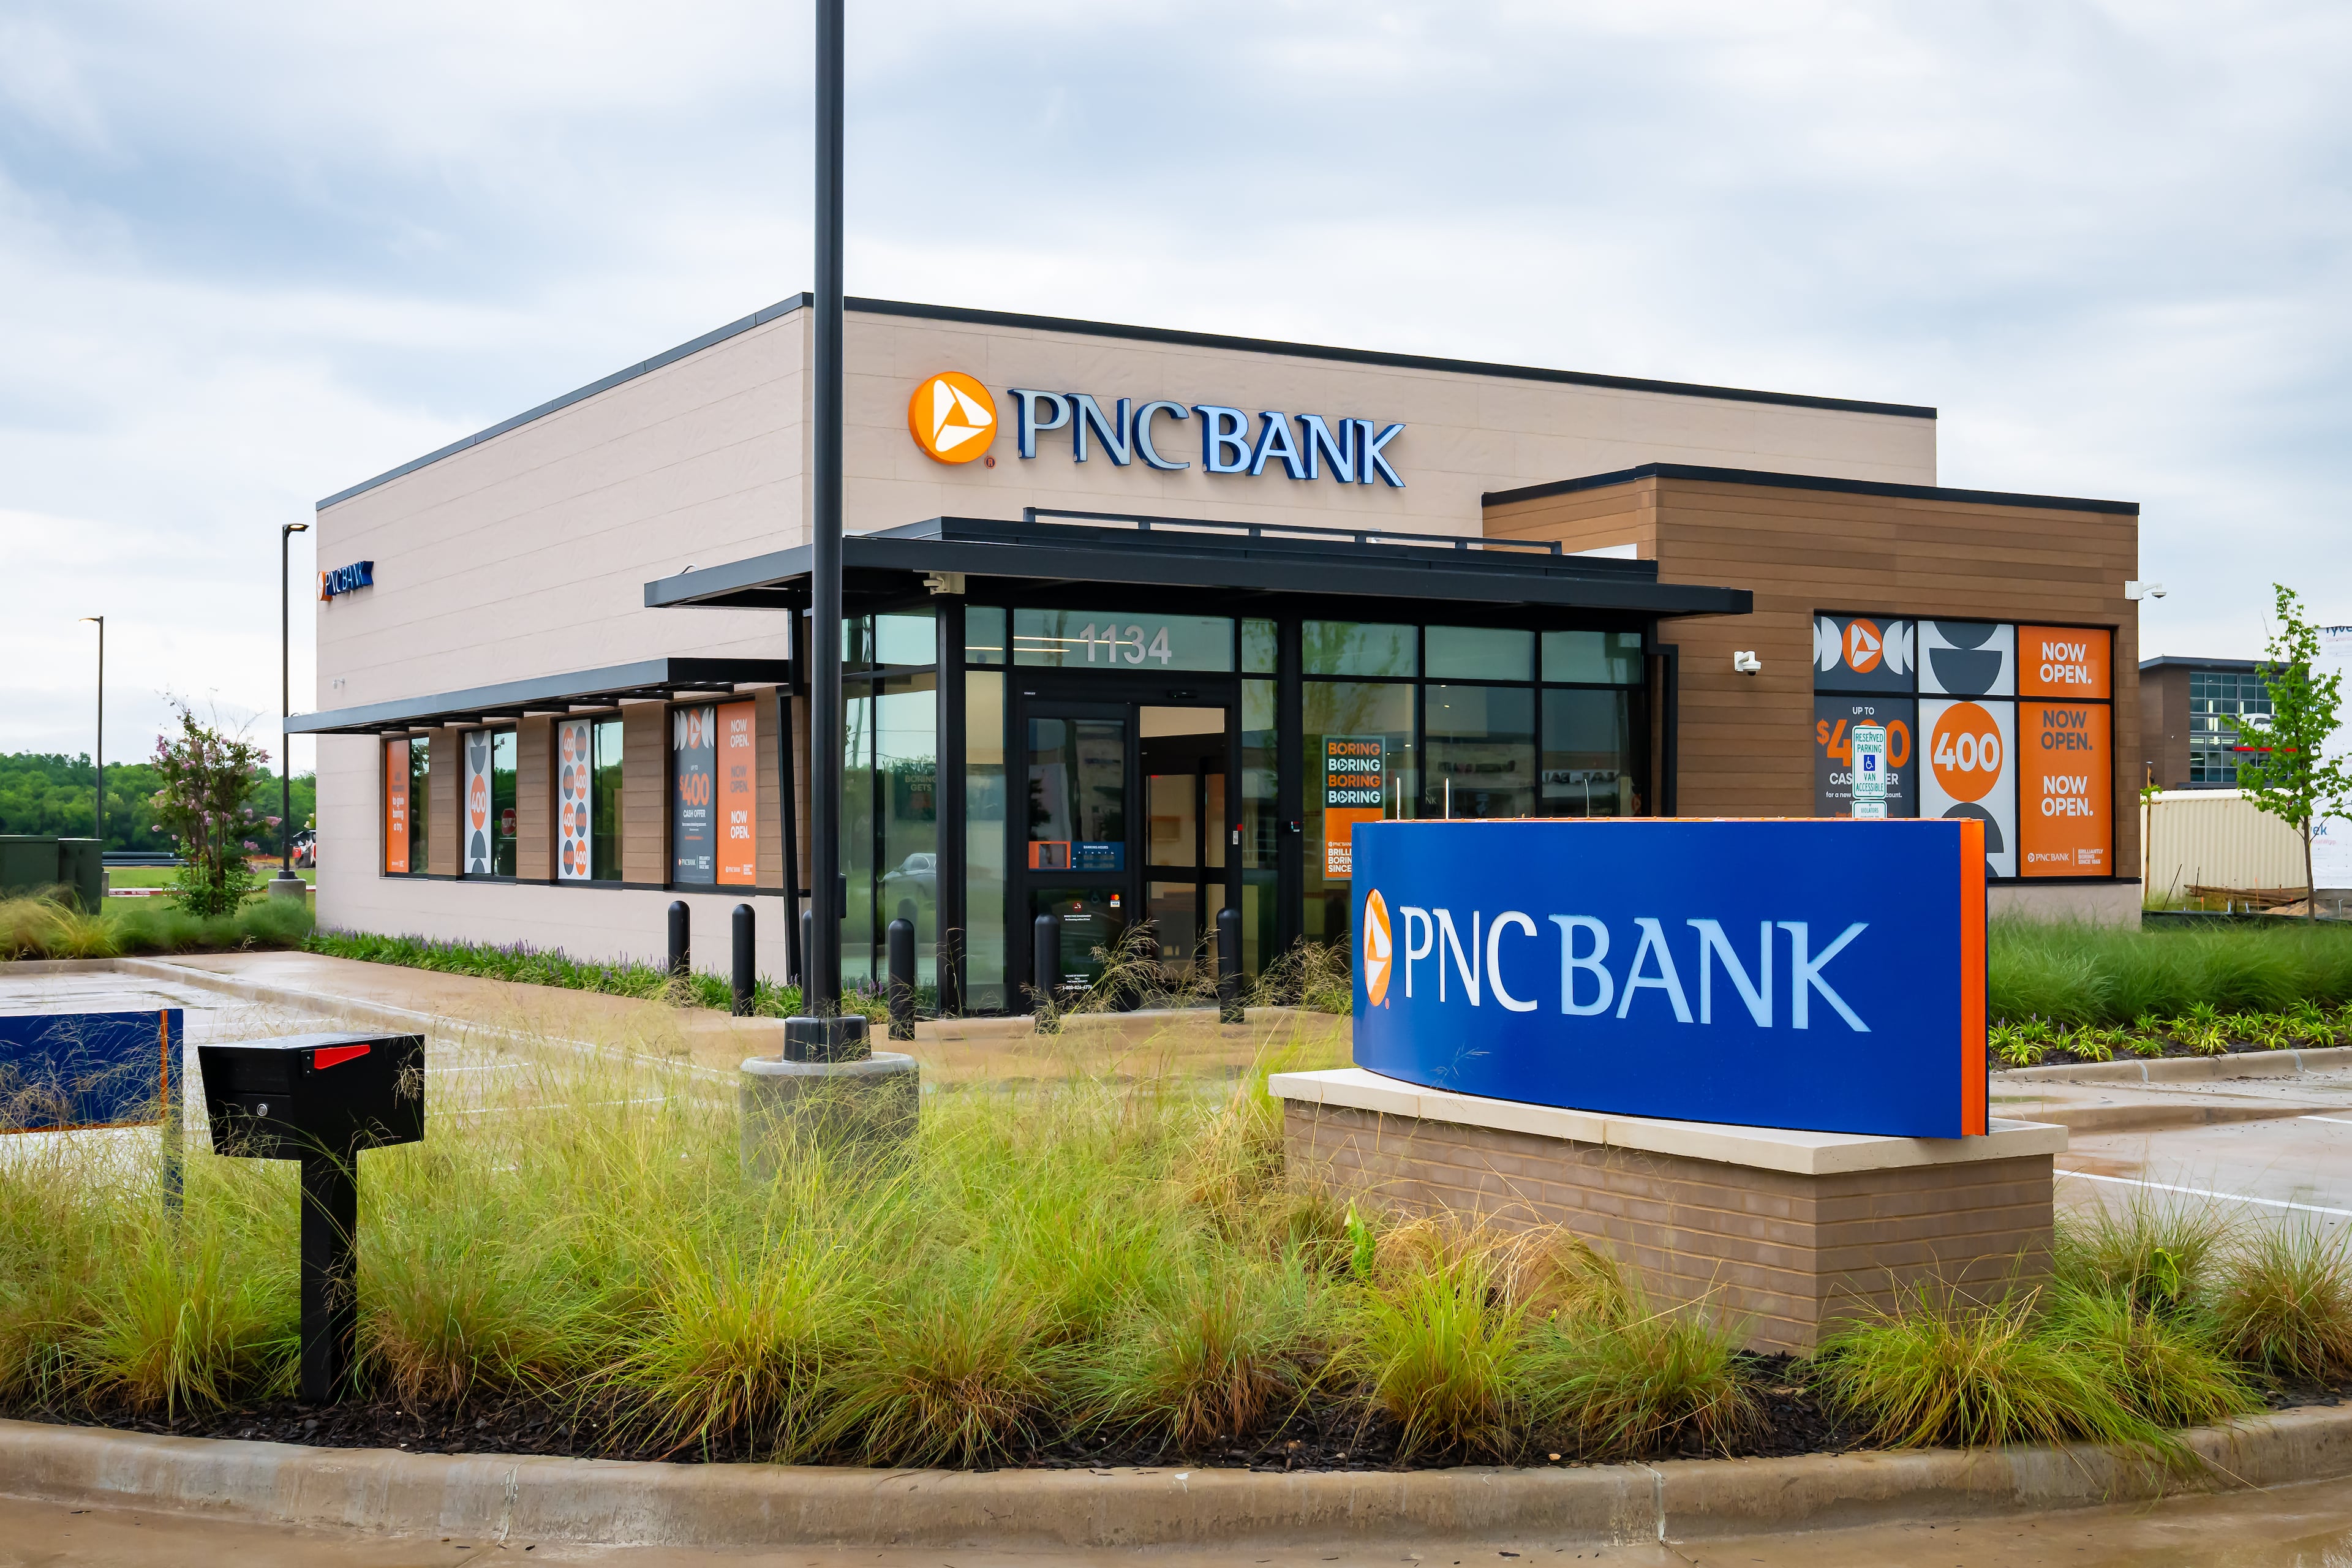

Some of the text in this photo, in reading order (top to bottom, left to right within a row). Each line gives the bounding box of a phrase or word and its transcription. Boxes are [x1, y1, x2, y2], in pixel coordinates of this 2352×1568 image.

[1008, 388, 1406, 488] PNC BANK
[1080, 623, 1172, 665] 1134
[2042, 642, 2086, 662] NOW
[2040, 663, 2092, 684] OPEN.
[1852, 706, 1875, 715] UP TO
[731, 718, 747, 733] NOW
[2043, 710, 2087, 728] NOW
[564, 737, 575, 752] 400
[730, 734, 750, 748] OPEN.
[1817, 718, 1910, 768] $40
[1855, 733, 1883, 743] RESERVED
[2041, 731, 2093, 751] OPEN.
[1329, 742, 1381, 755] BORING
[1857, 744, 1882, 753] PARKING
[1934, 732, 2000, 772] 400
[731, 765, 747, 778] NOW
[1329, 758, 1381, 772] BORING
[576, 774, 586, 788] 400
[1329, 774, 1381, 787] BORING
[1830, 772, 1853, 785] CAS
[1864, 773, 1876, 782] VAN
[2043, 775, 2087, 794] NOW
[679, 773, 710, 806] $400
[1856, 783, 1884, 792] ACCESSIBLE
[471, 791, 486, 813] 400
[1329, 790, 1381, 804] BORING
[683, 809, 706, 818] CASH OFFER
[2041, 797, 2094, 816] OPEN.
[564, 813, 575, 827] 400
[731, 810, 748, 823] NOW
[730, 826, 750, 839] OPEN.
[576, 851, 586, 864] 400
[2035, 853, 2070, 862] PNC BANK
[1400, 906, 1872, 1033] PNC BANK
